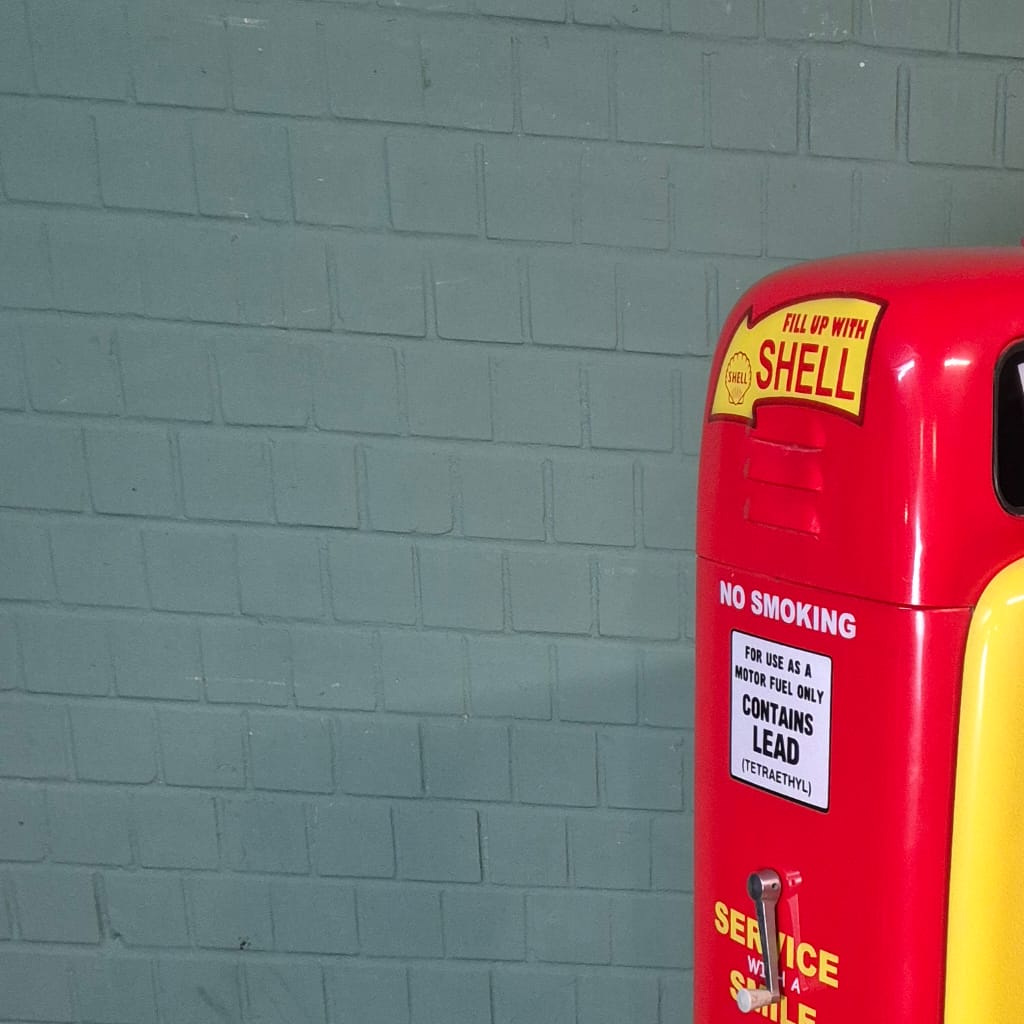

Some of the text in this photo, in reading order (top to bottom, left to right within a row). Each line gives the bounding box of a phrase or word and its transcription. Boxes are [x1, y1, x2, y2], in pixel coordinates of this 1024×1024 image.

[782, 313, 869, 340] FILL UP WITH
[727, 370, 748, 385] SHELL
[756, 339, 855, 401] SHELL
[719, 580, 857, 639] NO SMOKING
[745, 645, 812, 678] FOR USE AS A
[735, 665, 825, 705] MOTOR FUEL ONLY
[742, 693, 813, 736] CONTAINS
[752, 725, 800, 766] LEAD
[741, 758, 812, 797] (TETRAETHYL)
[791, 977, 800, 994] A
